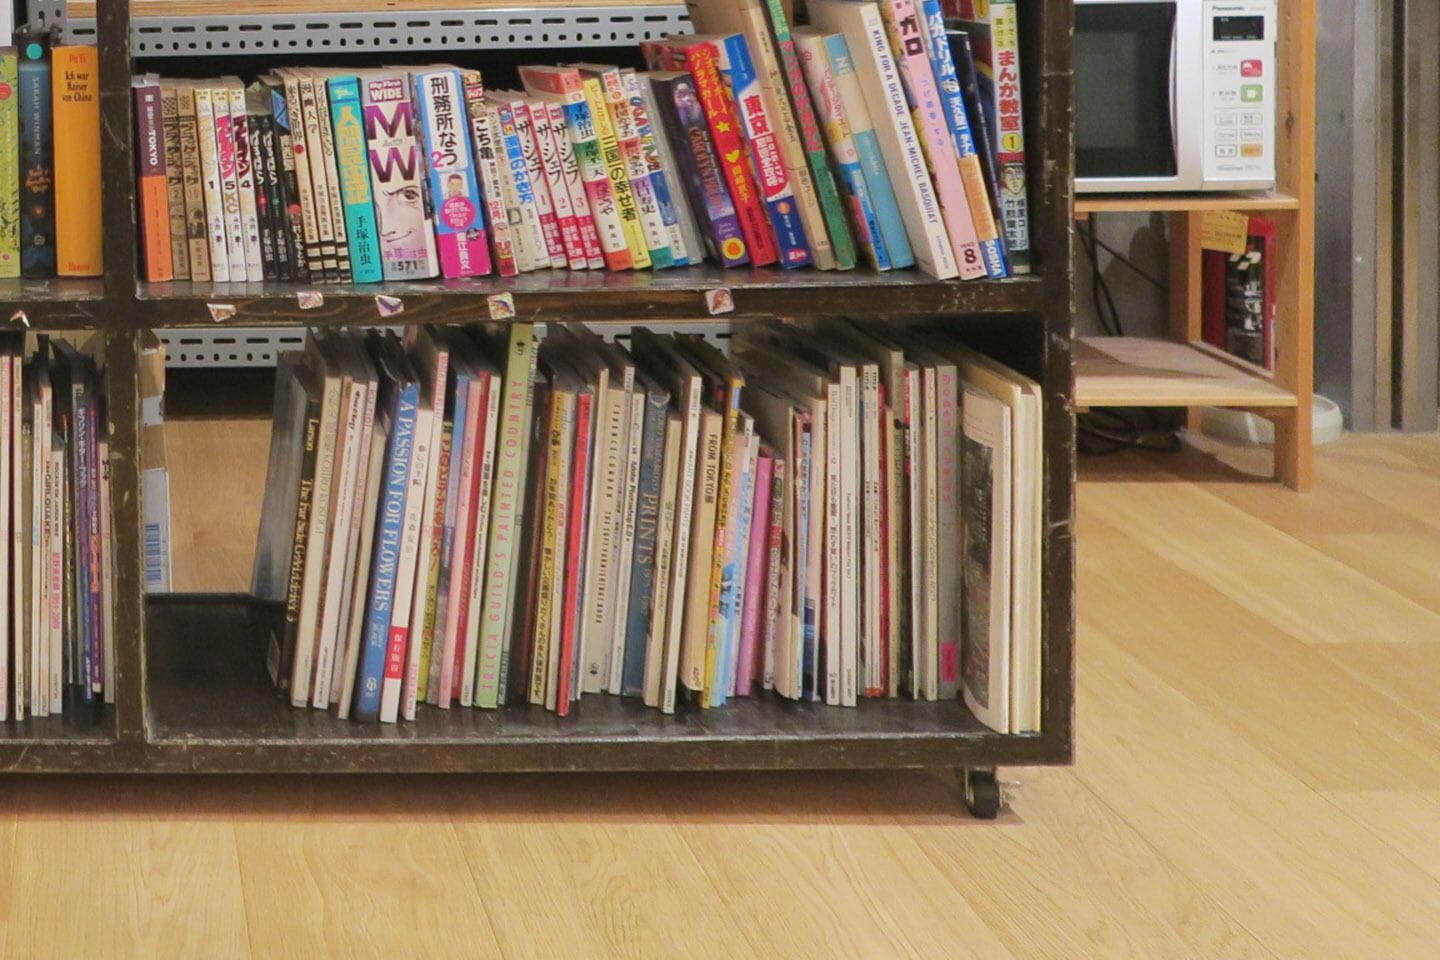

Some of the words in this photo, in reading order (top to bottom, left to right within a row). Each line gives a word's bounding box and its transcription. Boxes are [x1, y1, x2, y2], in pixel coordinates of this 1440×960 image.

[899, 14, 925, 56] ガロ
[65, 71, 76, 82] Ich
[370, 89, 404, 100] WIDE
[998, 49, 1019, 132] まんが教室
[74, 92, 92, 102] China
[743, 94, 769, 136] 東京
[363, 102, 415, 140] M
[474, 119, 494, 159] こち亀
[873, 29, 884, 50] KING
[880, 51, 890, 70] FOR
[889, 78, 901, 116] DECADE
[900, 118, 921, 181] JEAN-MICHEL
[918, 182, 939, 225] BASQUIAT
[149, 129, 158, 166] TOKYO
[369, 145, 417, 183] W
[431, 150, 444, 168] 2
[224, 181, 235, 190] 5
[241, 181, 251, 190] 4
[602, 136, 636, 221] 三国一の幸せ者
[264, 227, 274, 262] 手塚治虫
[277, 228, 288, 262] 手塚治虫
[356, 215, 373, 266] 手塚治虫
[964, 248, 977, 264] 8
[397, 261, 417, 271] 571
[399, 399, 412, 412] A
[503, 380, 522, 459] COUNTRY
[304, 418, 319, 451] Larson
[389, 416, 413, 486] PASSION
[706, 433, 718, 460] FROM
[299, 478, 313, 501] The
[702, 463, 717, 504] TOKYO展
[384, 490, 404, 525] FOR
[495, 469, 514, 541] PAINTED
[294, 520, 308, 543] Side
[635, 491, 659, 565] PRINTS
[373, 528, 399, 612] FLOWERS
[487, 552, 506, 622] GUILD'S
[481, 632, 498, 691] TRICIA
